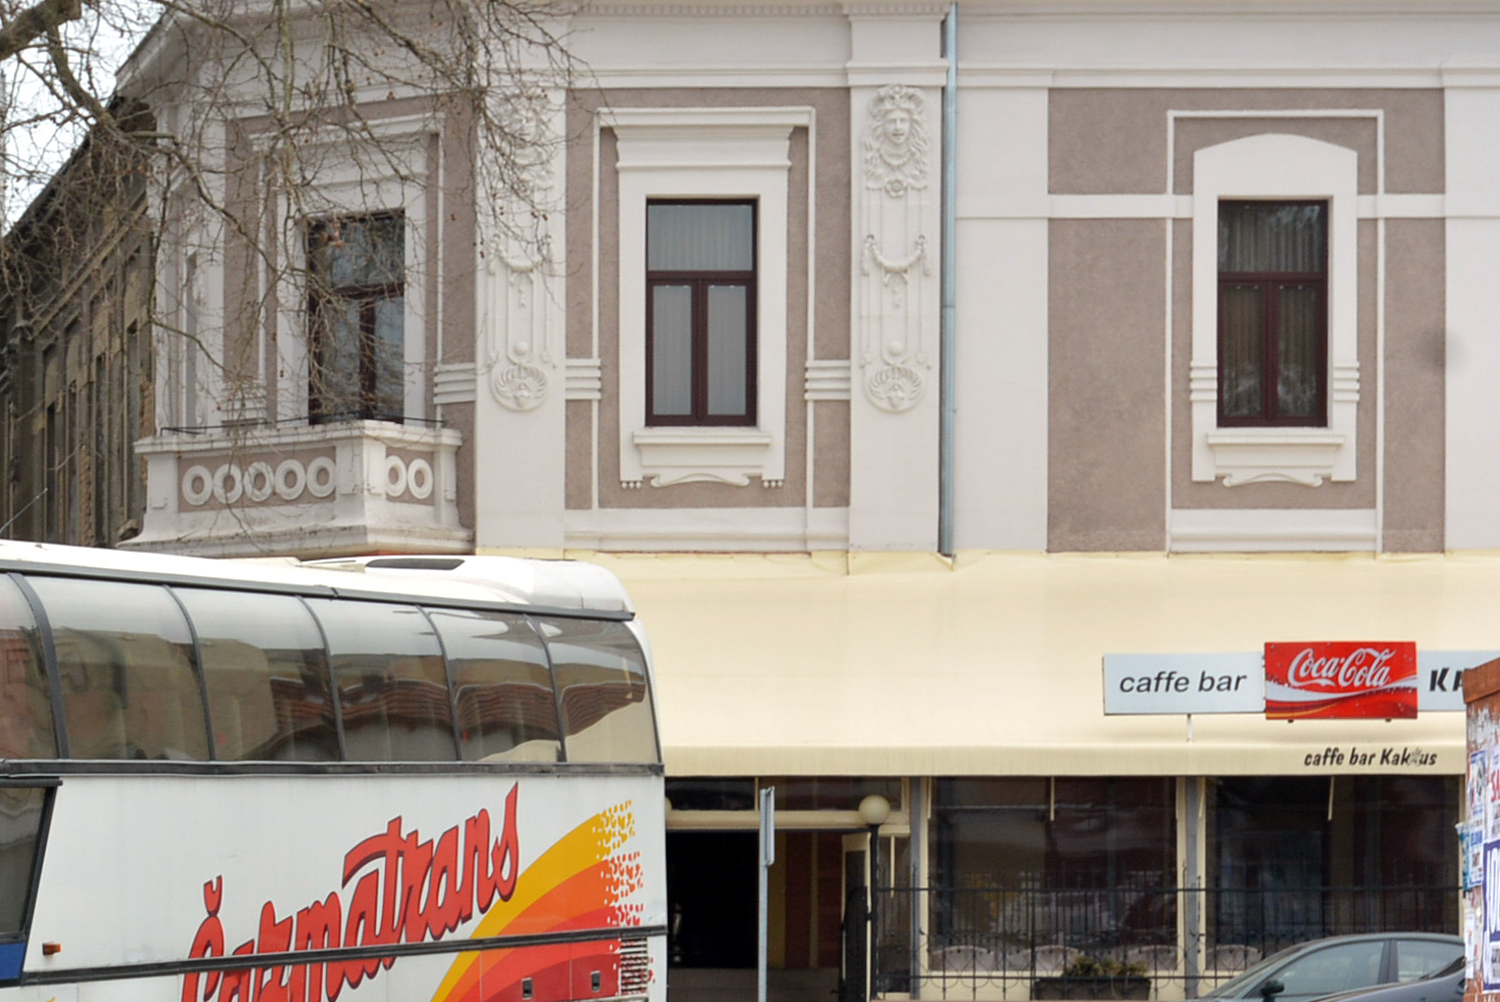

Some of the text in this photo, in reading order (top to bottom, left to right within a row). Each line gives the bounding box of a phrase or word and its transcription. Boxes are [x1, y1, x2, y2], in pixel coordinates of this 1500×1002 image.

[1287, 647, 1397, 687] Coca-Cola
[1119, 669, 1248, 693] caffe bar
[1303, 746, 1438, 767] caffe bar Kakus
